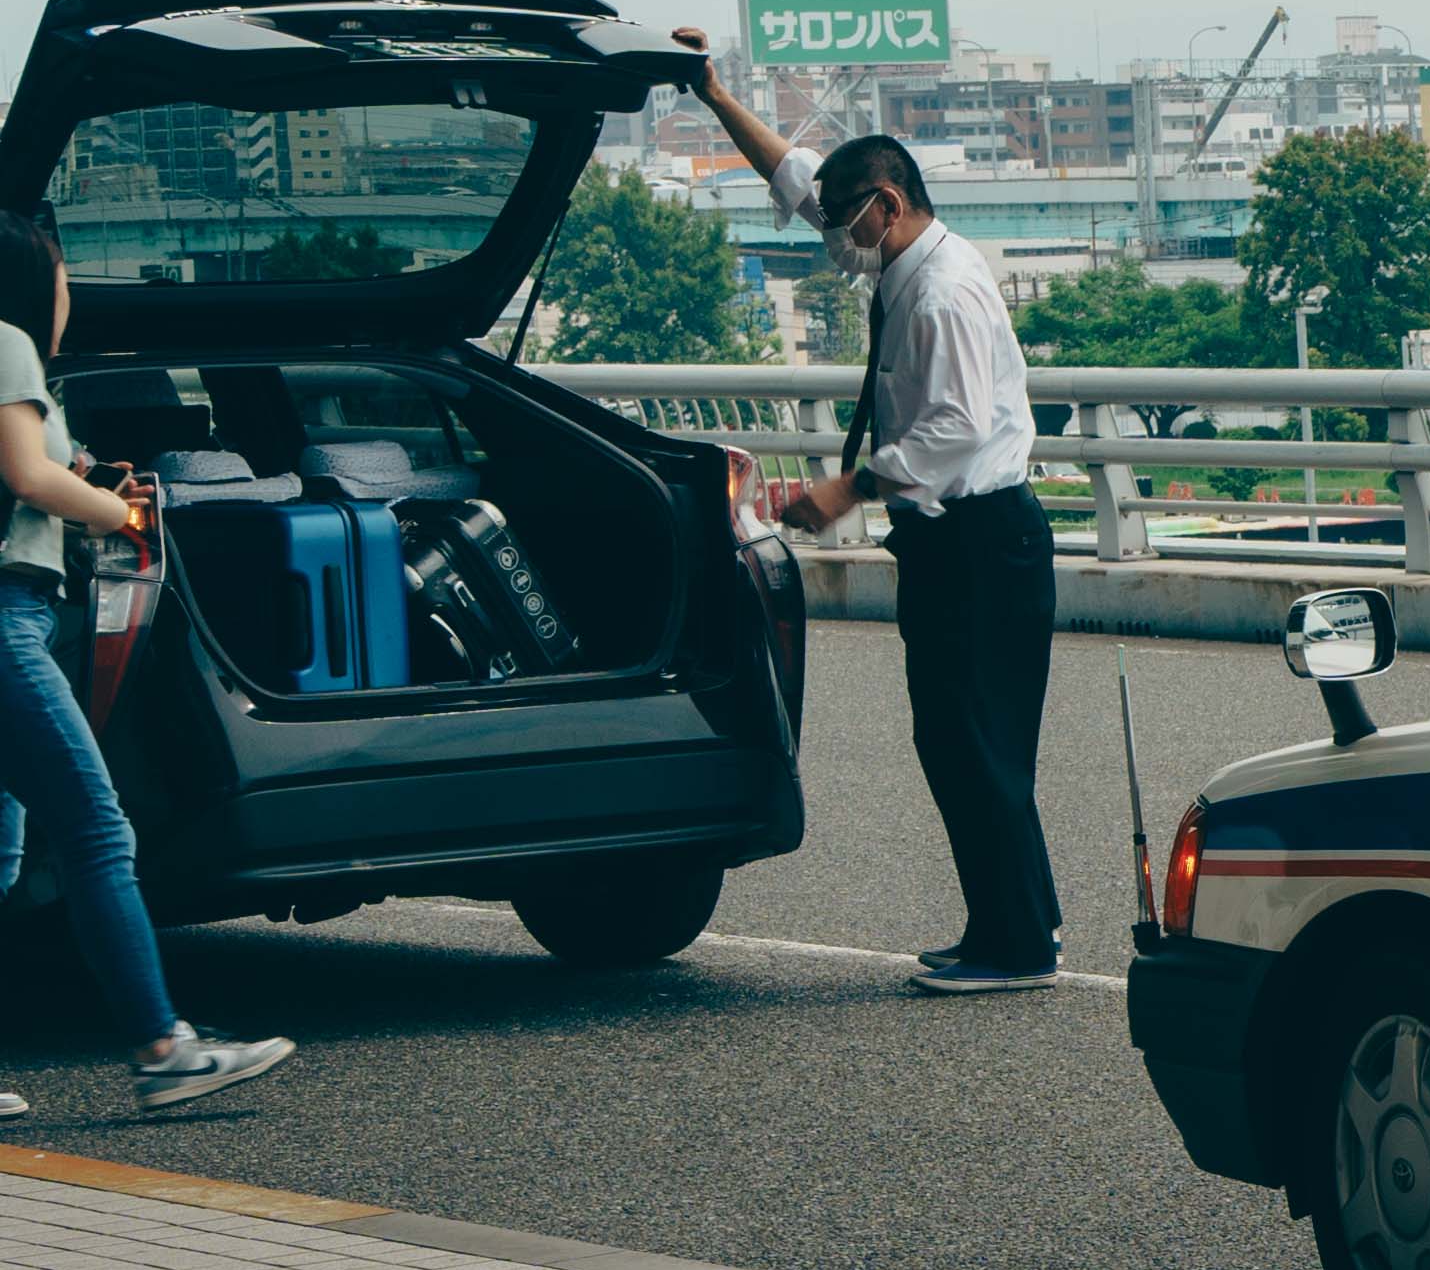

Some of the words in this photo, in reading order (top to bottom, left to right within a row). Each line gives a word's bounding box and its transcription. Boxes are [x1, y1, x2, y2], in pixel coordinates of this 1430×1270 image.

[760, 8, 941, 51] サロンパス
